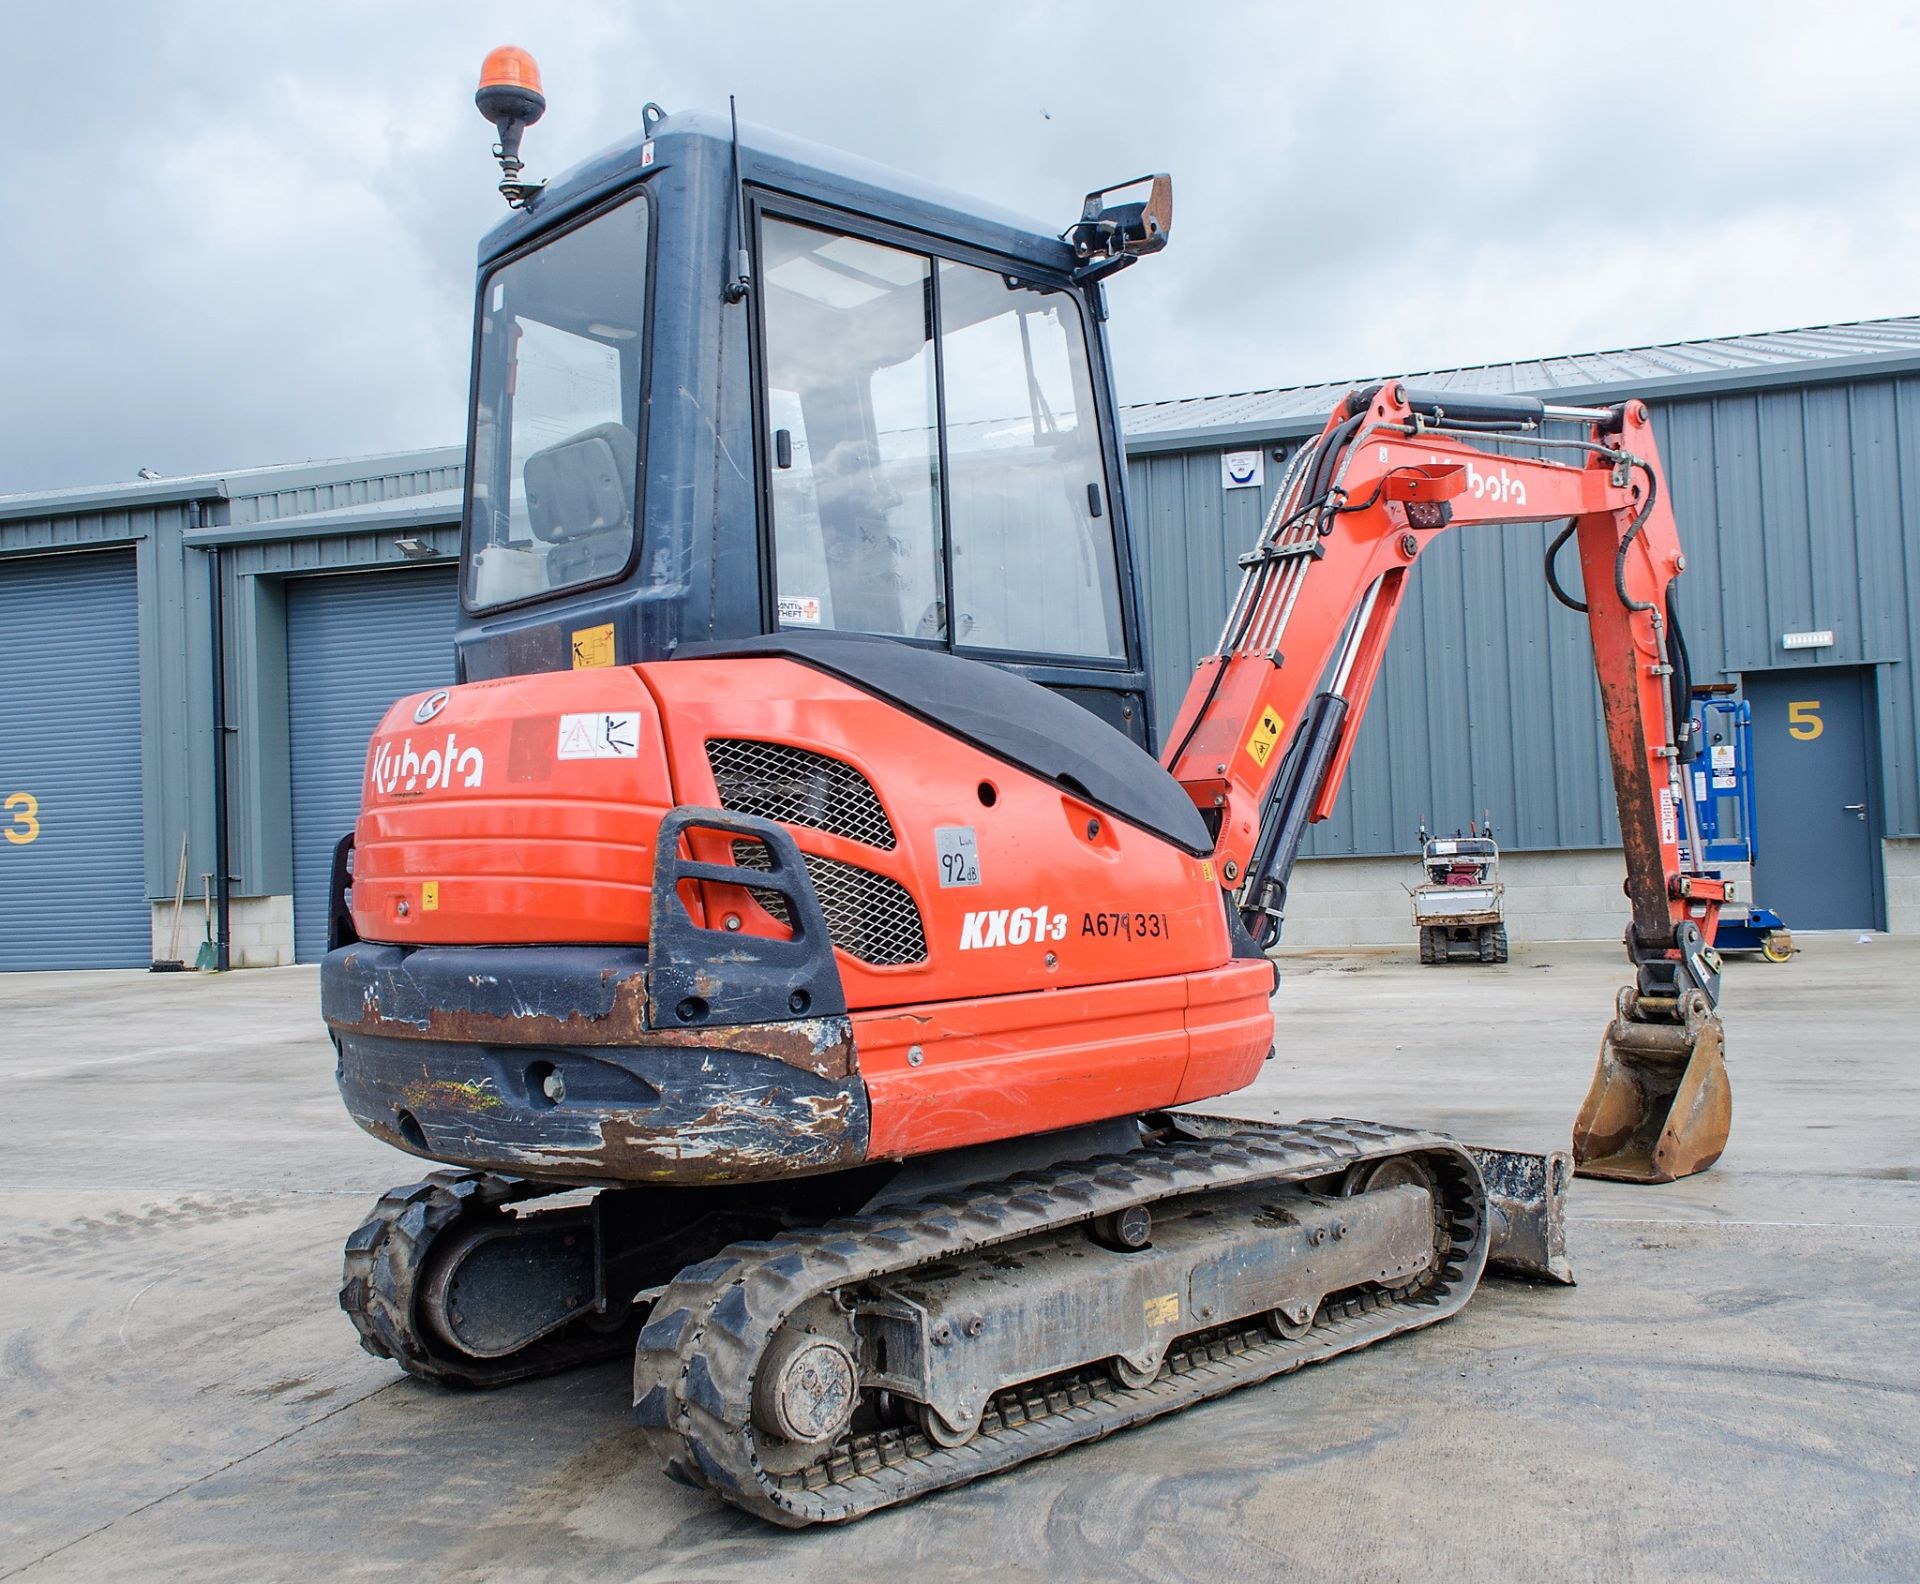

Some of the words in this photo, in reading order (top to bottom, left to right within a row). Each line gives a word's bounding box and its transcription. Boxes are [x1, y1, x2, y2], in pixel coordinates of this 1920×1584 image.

[1788, 700, 1824, 741] 5
[371, 733, 484, 794] Kubota
[3, 792, 40, 845] 3
[942, 852, 966, 882] 92
[966, 866, 977, 881] dB
[959, 905, 1068, 951] KX61-3
